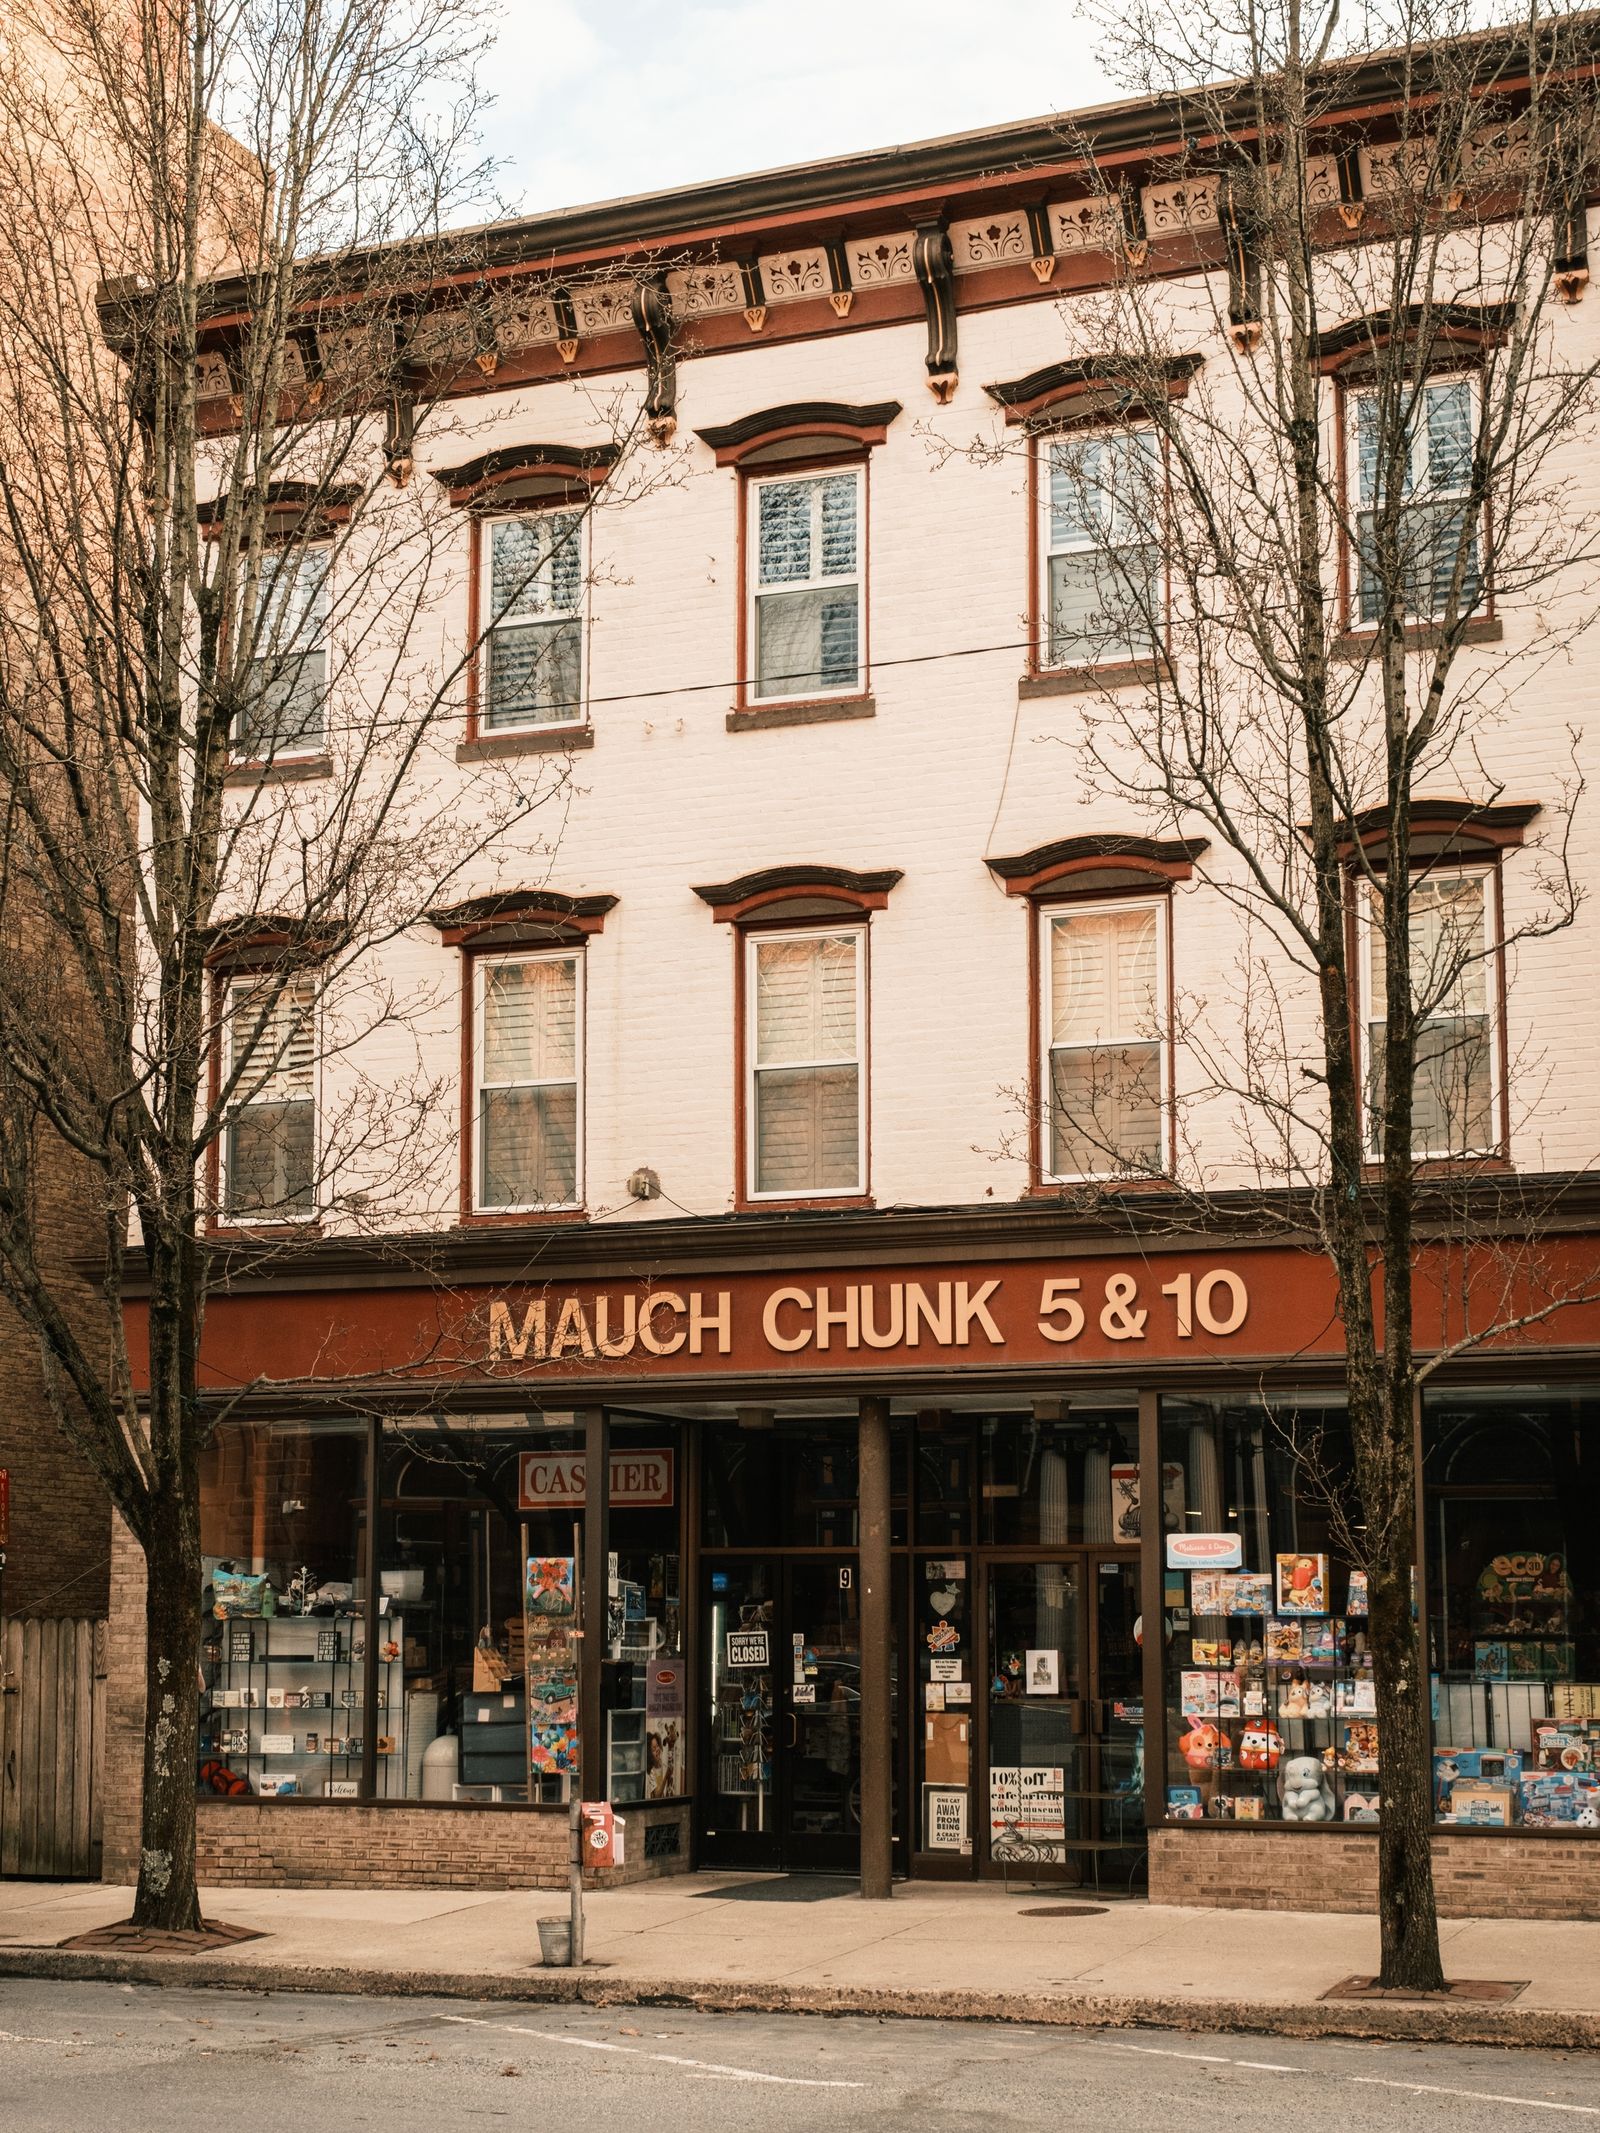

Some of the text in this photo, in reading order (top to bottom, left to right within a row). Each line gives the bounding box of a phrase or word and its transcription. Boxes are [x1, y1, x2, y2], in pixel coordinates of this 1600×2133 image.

[489, 1269, 1248, 1361] MAUCH CHUNK 5 & 10
[530, 1463, 662, 1495] CASIER
[1491, 1553, 1545, 1576] eco
[841, 1569, 850, 1588] 9
[731, 1636, 765, 1646] SORRY WE'RE
[732, 1646, 766, 1663] CLOSED
[1541, 1736, 1566, 1748] Pasta
[992, 1772, 1018, 1786] 10%
[1024, 1772, 1048, 1786] off
[991, 1791, 1017, 1800] cafe
[936, 1804, 960, 1816] AWAY
[1023, 1806, 1062, 1815] museum
